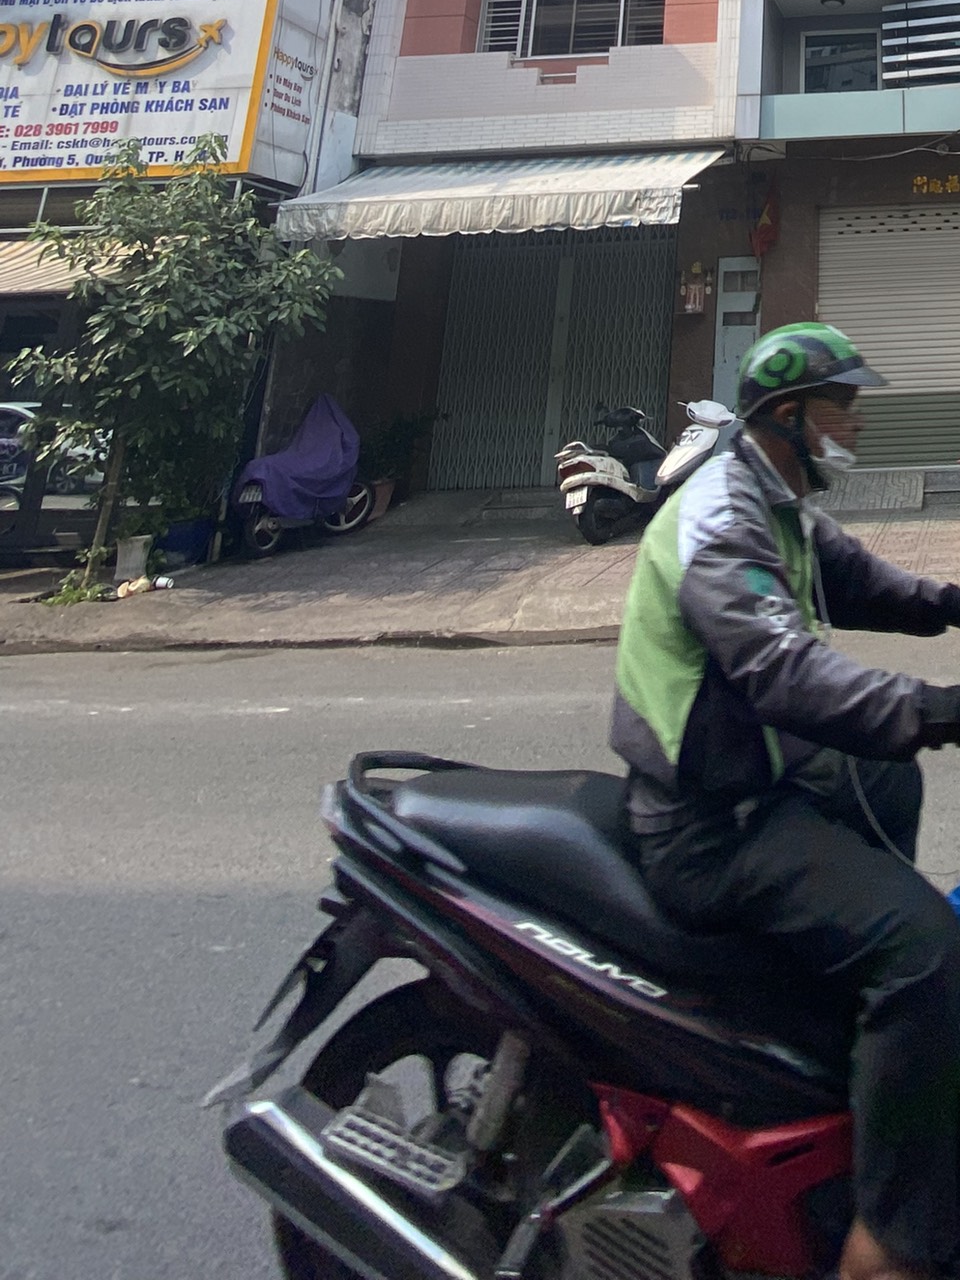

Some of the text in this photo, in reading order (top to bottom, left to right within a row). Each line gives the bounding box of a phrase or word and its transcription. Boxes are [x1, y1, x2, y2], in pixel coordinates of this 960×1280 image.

[273, 46, 314, 76] Happytours
[64, 83, 90, 99] ĐẠI
[90, 98, 140, 116] PHÒNG
[145, 96, 195, 113] KHÁCH
[198, 97, 230, 113] SẠN
[14, 124, 42, 137] 028
[45, 123, 80, 136] 3961
[83, 120, 119, 135] 7999
[11, 139, 53, 151] Email:
[67, 154, 79, 167] 5,
[148, 151, 168, 164] TP.
